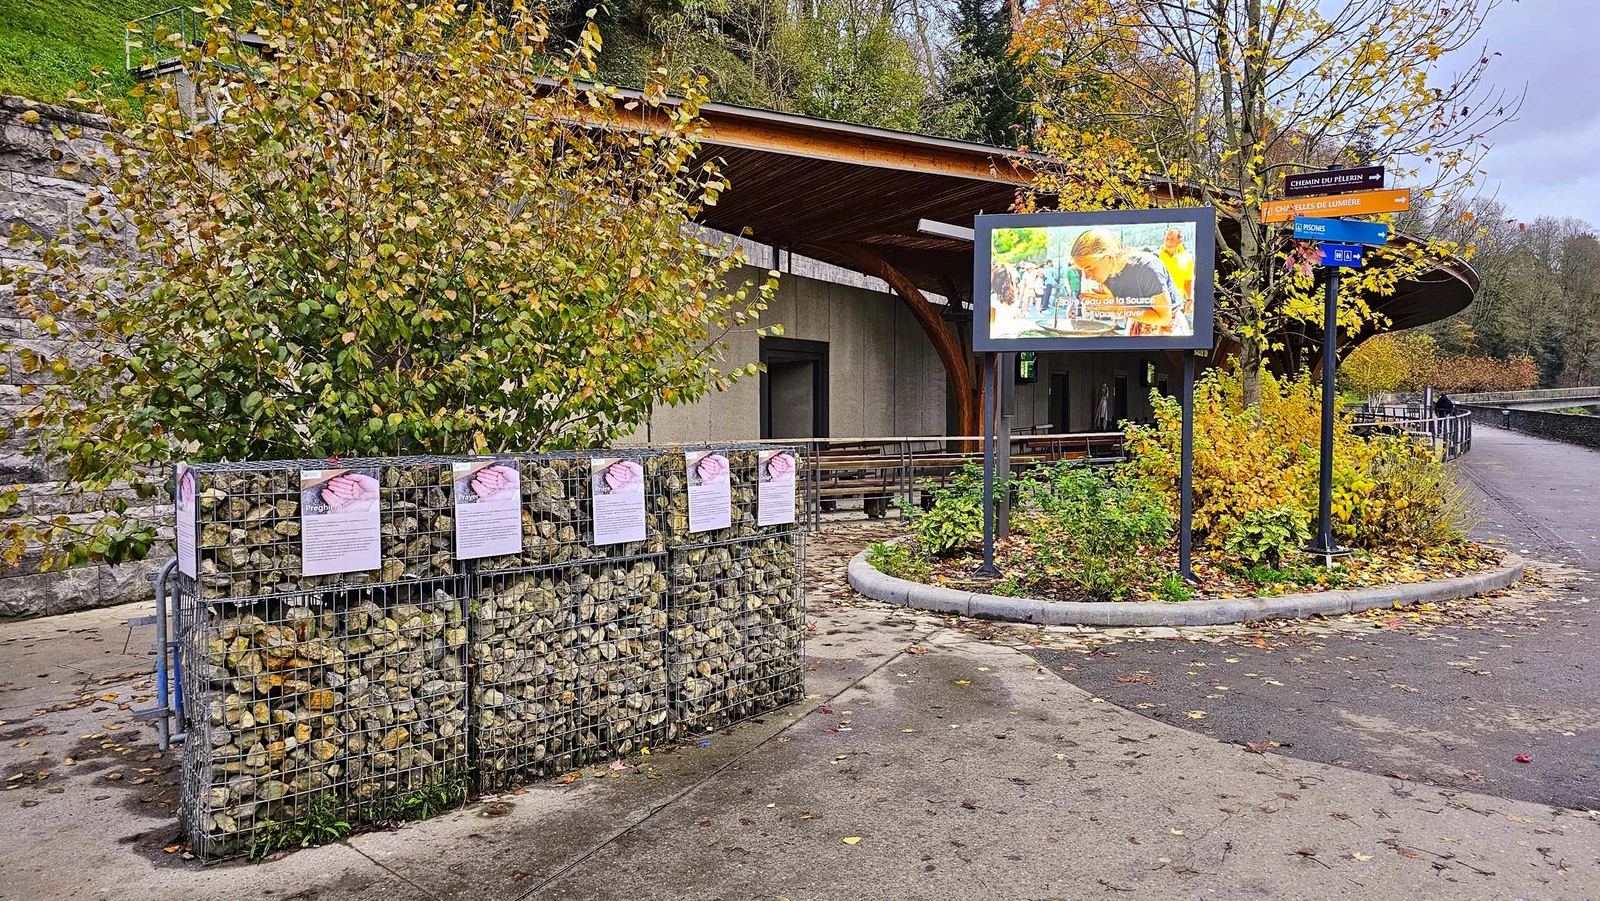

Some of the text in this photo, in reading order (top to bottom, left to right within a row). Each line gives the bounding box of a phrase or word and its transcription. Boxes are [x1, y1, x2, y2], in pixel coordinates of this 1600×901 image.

[1290, 179, 1320, 187] CHEMIN
[1334, 174, 1363, 183] PÈLERIN
[1328, 198, 1361, 208] LUMIÈRE
[1303, 223, 1326, 232] PISCINES
[1103, 297, 1113, 305] de
[1116, 296, 1125, 304] la
[1125, 296, 1156, 305] Source
[1116, 311, 1122, 319] y
[1123, 310, 1146, 318] laver
